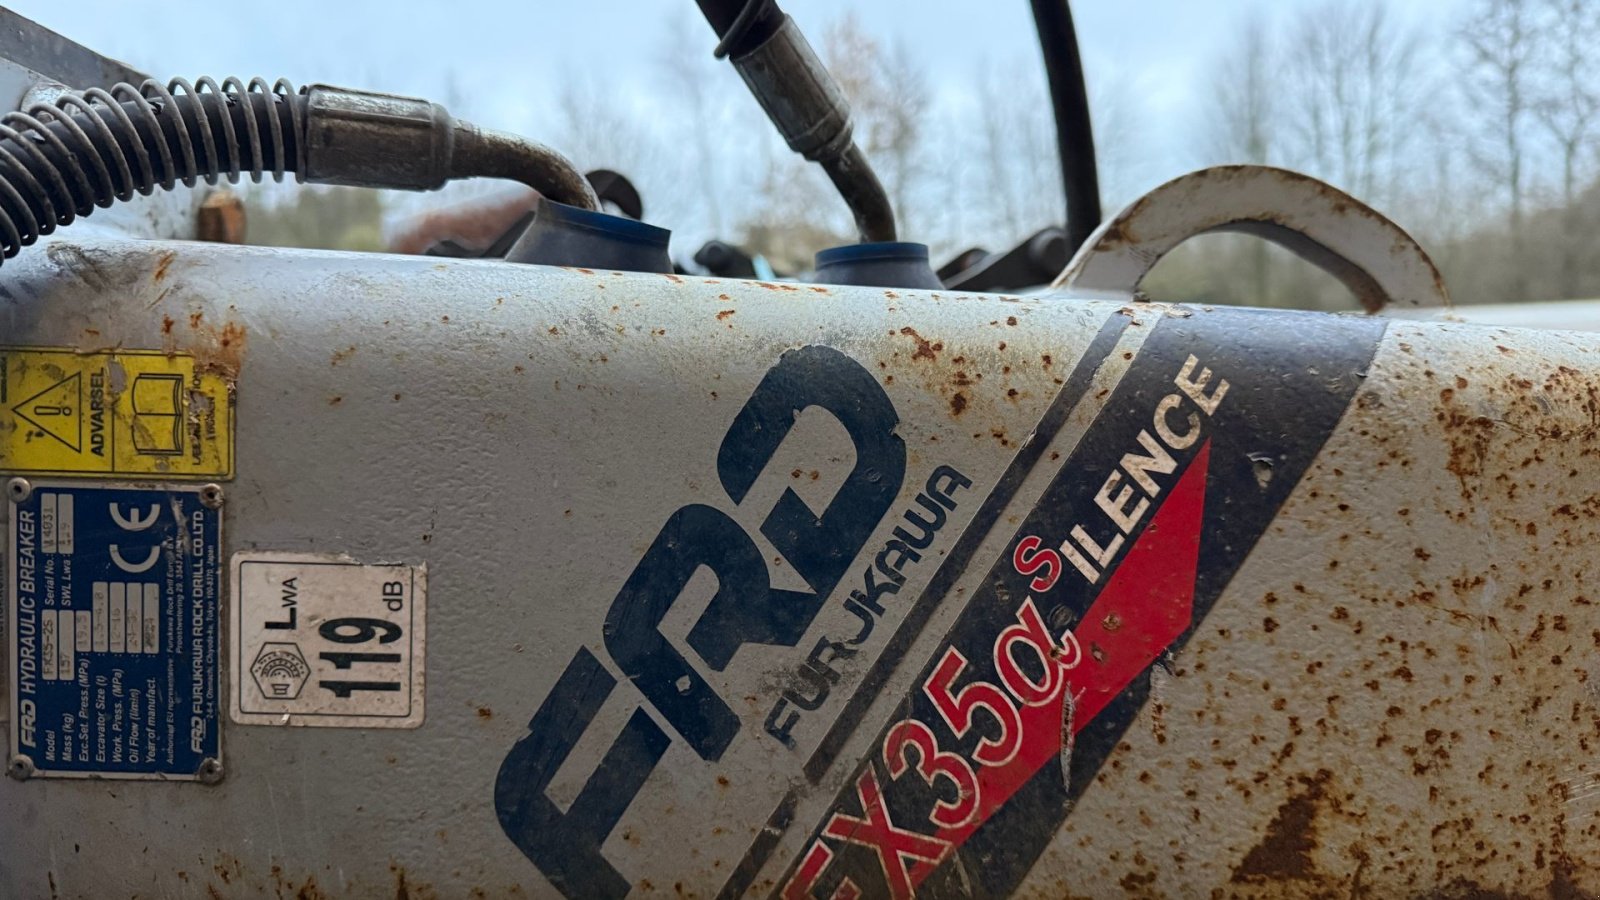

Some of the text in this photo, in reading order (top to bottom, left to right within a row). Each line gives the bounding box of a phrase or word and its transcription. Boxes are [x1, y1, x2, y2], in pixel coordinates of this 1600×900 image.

[90, 367, 104, 457] ADVARSEL
[109, 502, 161, 573] CE
[44, 576, 55, 606] Serial
[192, 558, 204, 598] DRILL
[61, 583, 72, 607] SWL
[166, 597, 174, 616] Rock
[763, 464, 972, 751] FURUKAWA
[19, 510, 37, 748] FRD HYDRAULIC BREAKER
[191, 599, 204, 637] ROCK
[494, 344, 907, 900] FRD
[166, 617, 174, 653] Furukawa
[319, 581, 404, 698] 119 dB
[96, 675, 108, 687] (t)
[112, 668, 124, 698] (MPa)
[191, 638, 204, 714] FURUKAWA
[96, 688, 106, 710] Size
[145, 677, 156, 727] manufact.
[62, 713, 74, 733] (kg)
[112, 700, 122, 732] Press.
[166, 711, 174, 723] EU
[45, 730, 56, 762] Model
[62, 735, 72, 762] Mass
[96, 712, 106, 763] Excavator
[112, 734, 122, 763] Work.
[129, 722, 139, 747] Flow
[145, 728, 156, 740] of
[190, 716, 204, 754] FRD
[129, 749, 139, 763] Oil
[145, 741, 156, 763] Year
